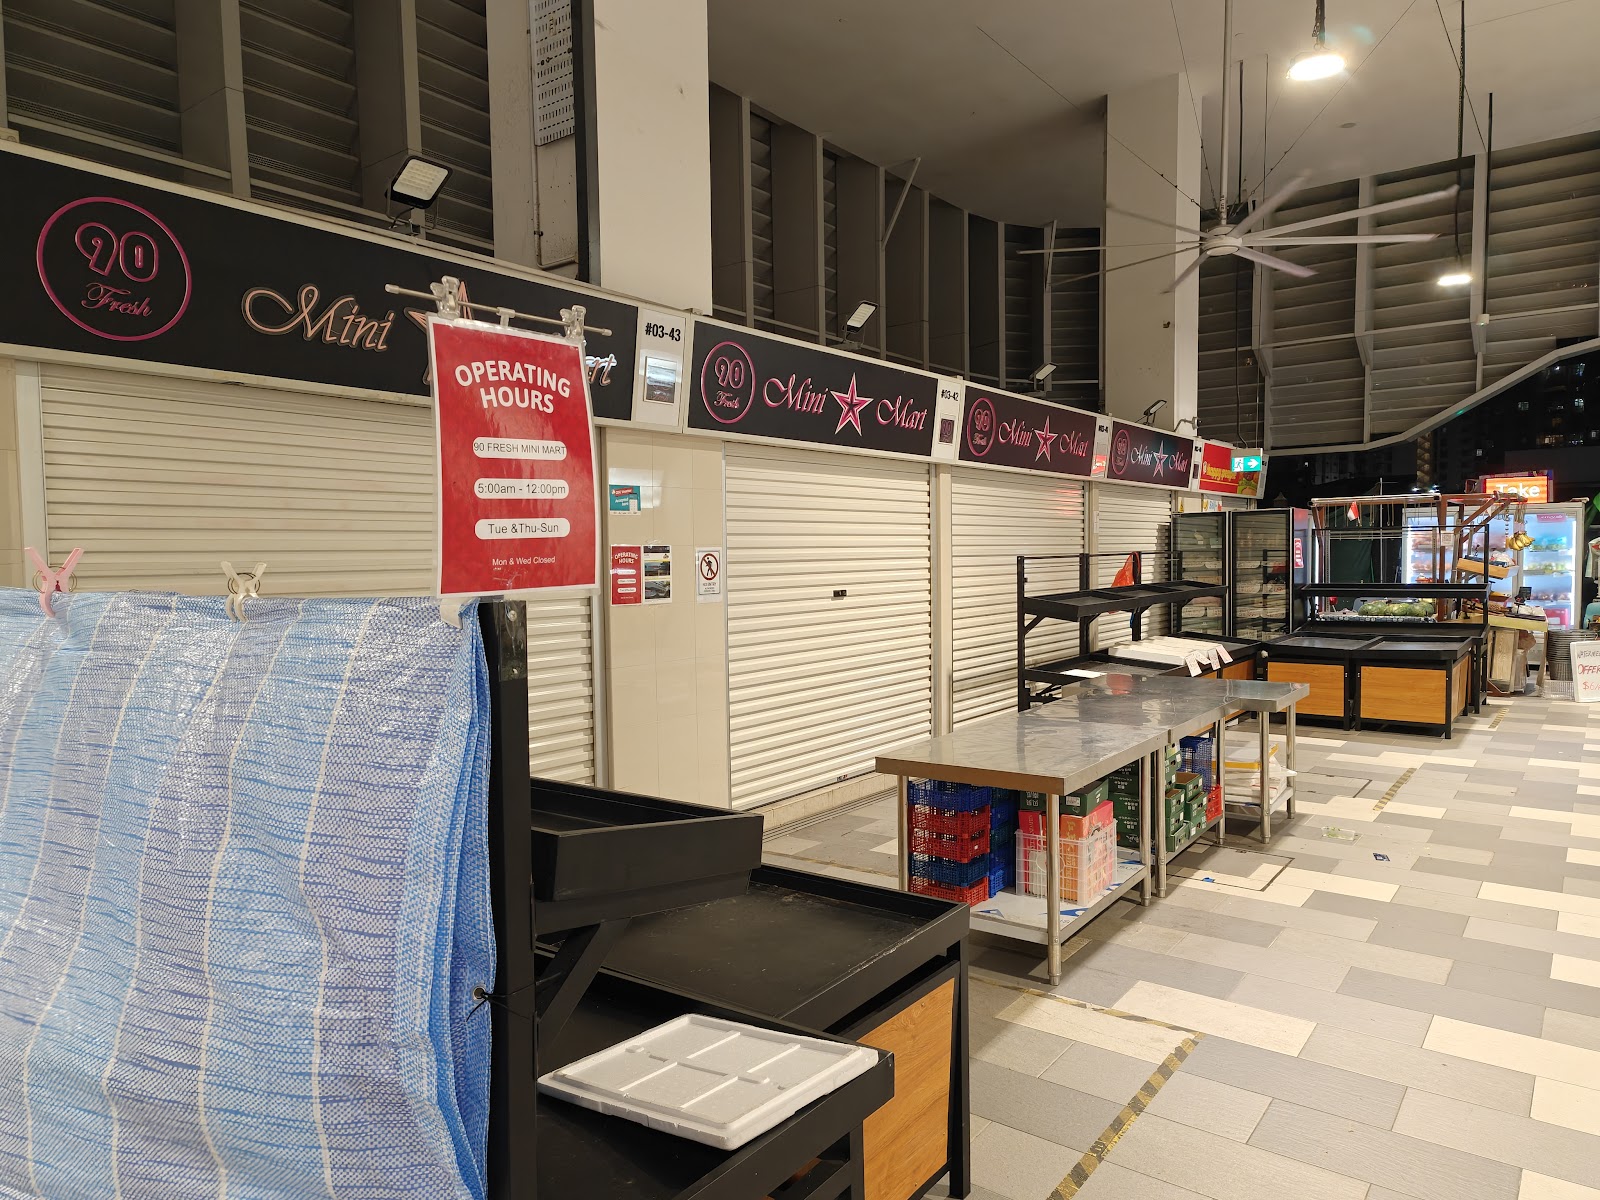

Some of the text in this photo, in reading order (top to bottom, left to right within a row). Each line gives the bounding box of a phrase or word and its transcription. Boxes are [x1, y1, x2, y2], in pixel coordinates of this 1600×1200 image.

[74, 221, 159, 283] 90
[81, 282, 153, 318] Fresh
[241, 283, 395, 351] Mini
[645, 322, 681, 342] #03-43
[455, 360, 571, 398] OPERATING
[714, 356, 745, 389] 90
[480, 386, 554, 414] HOURS
[762, 373, 928, 431] Mini Mart
[473, 442, 566, 455] 90 FRESH MINI MART
[998, 418, 1089, 457] Mini Mart
[477, 483, 516, 494] 5:00am
[526, 483, 566, 496] 12:00pm
[1495, 483, 1540, 498] Take
[488, 523, 508, 534] Tue
[492, 556, 556, 567] Mon & Wed Closed
